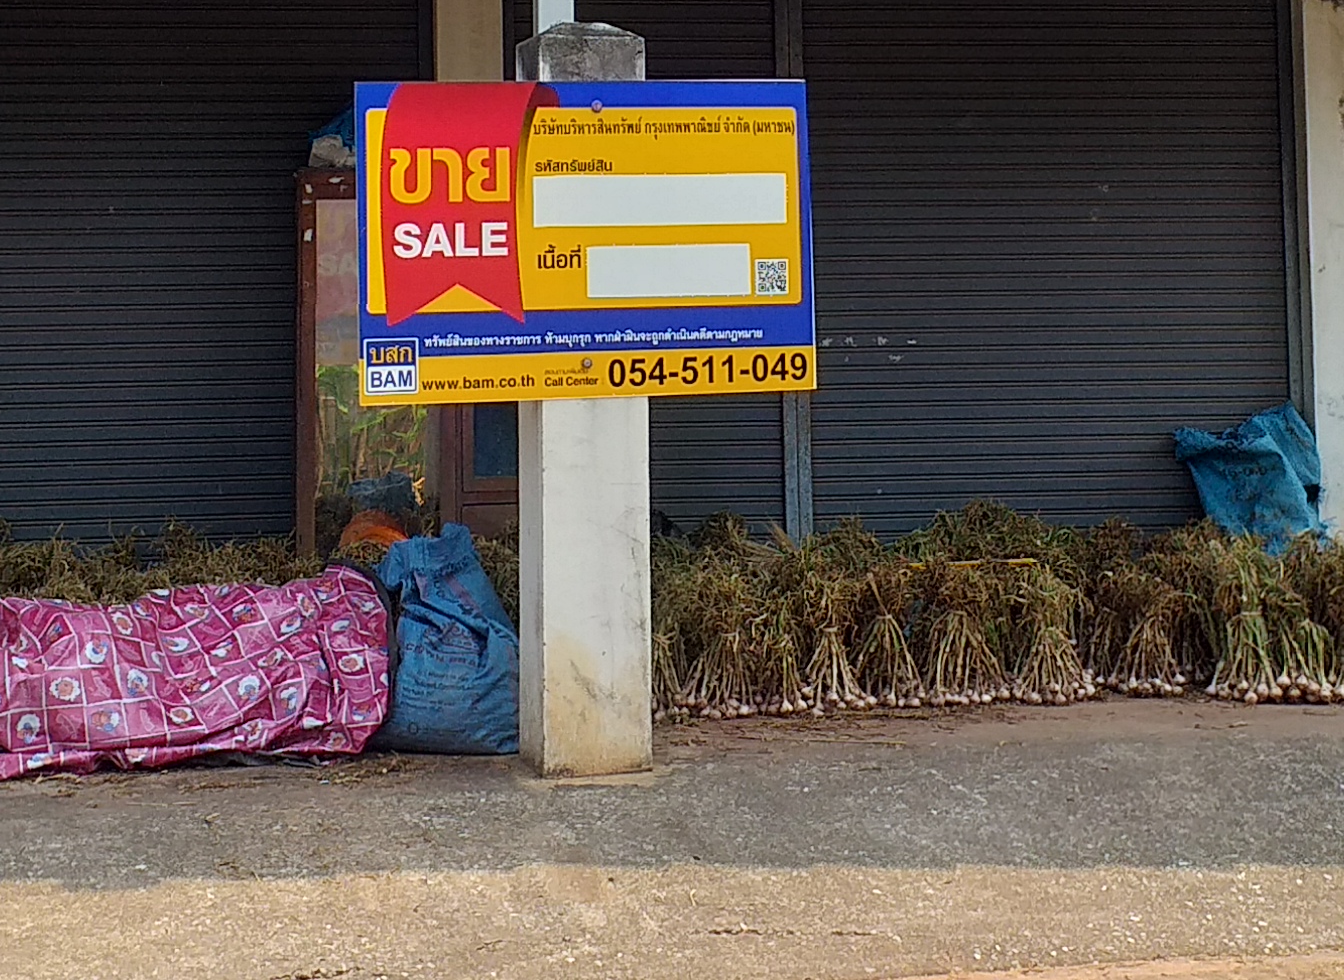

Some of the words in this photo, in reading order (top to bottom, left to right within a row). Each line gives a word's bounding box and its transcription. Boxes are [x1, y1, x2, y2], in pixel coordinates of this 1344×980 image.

[533, 117, 642, 135] บริษัทบริหารสินทรัพย์
[644, 116, 721, 140] กรุงเทพพาณิชย์
[723, 118, 750, 134] จำกัด
[752, 120, 795, 136] (มหาชน)
[534, 158, 614, 173] รหัสทรัพย์สิน
[388, 146, 511, 205] ขาย
[393, 221, 509, 259] SALE
[536, 244, 582, 271] เนื้อที่
[544, 331, 592, 348] ห้ามบุกรุก
[369, 345, 413, 364] บสก
[370, 370, 413, 388] BAM
[608, 353, 808, 388] 054-511-049
[422, 373, 535, 391] www.bam.co.th
[544, 376, 564, 387] Call
[565, 376, 599, 387] Center
